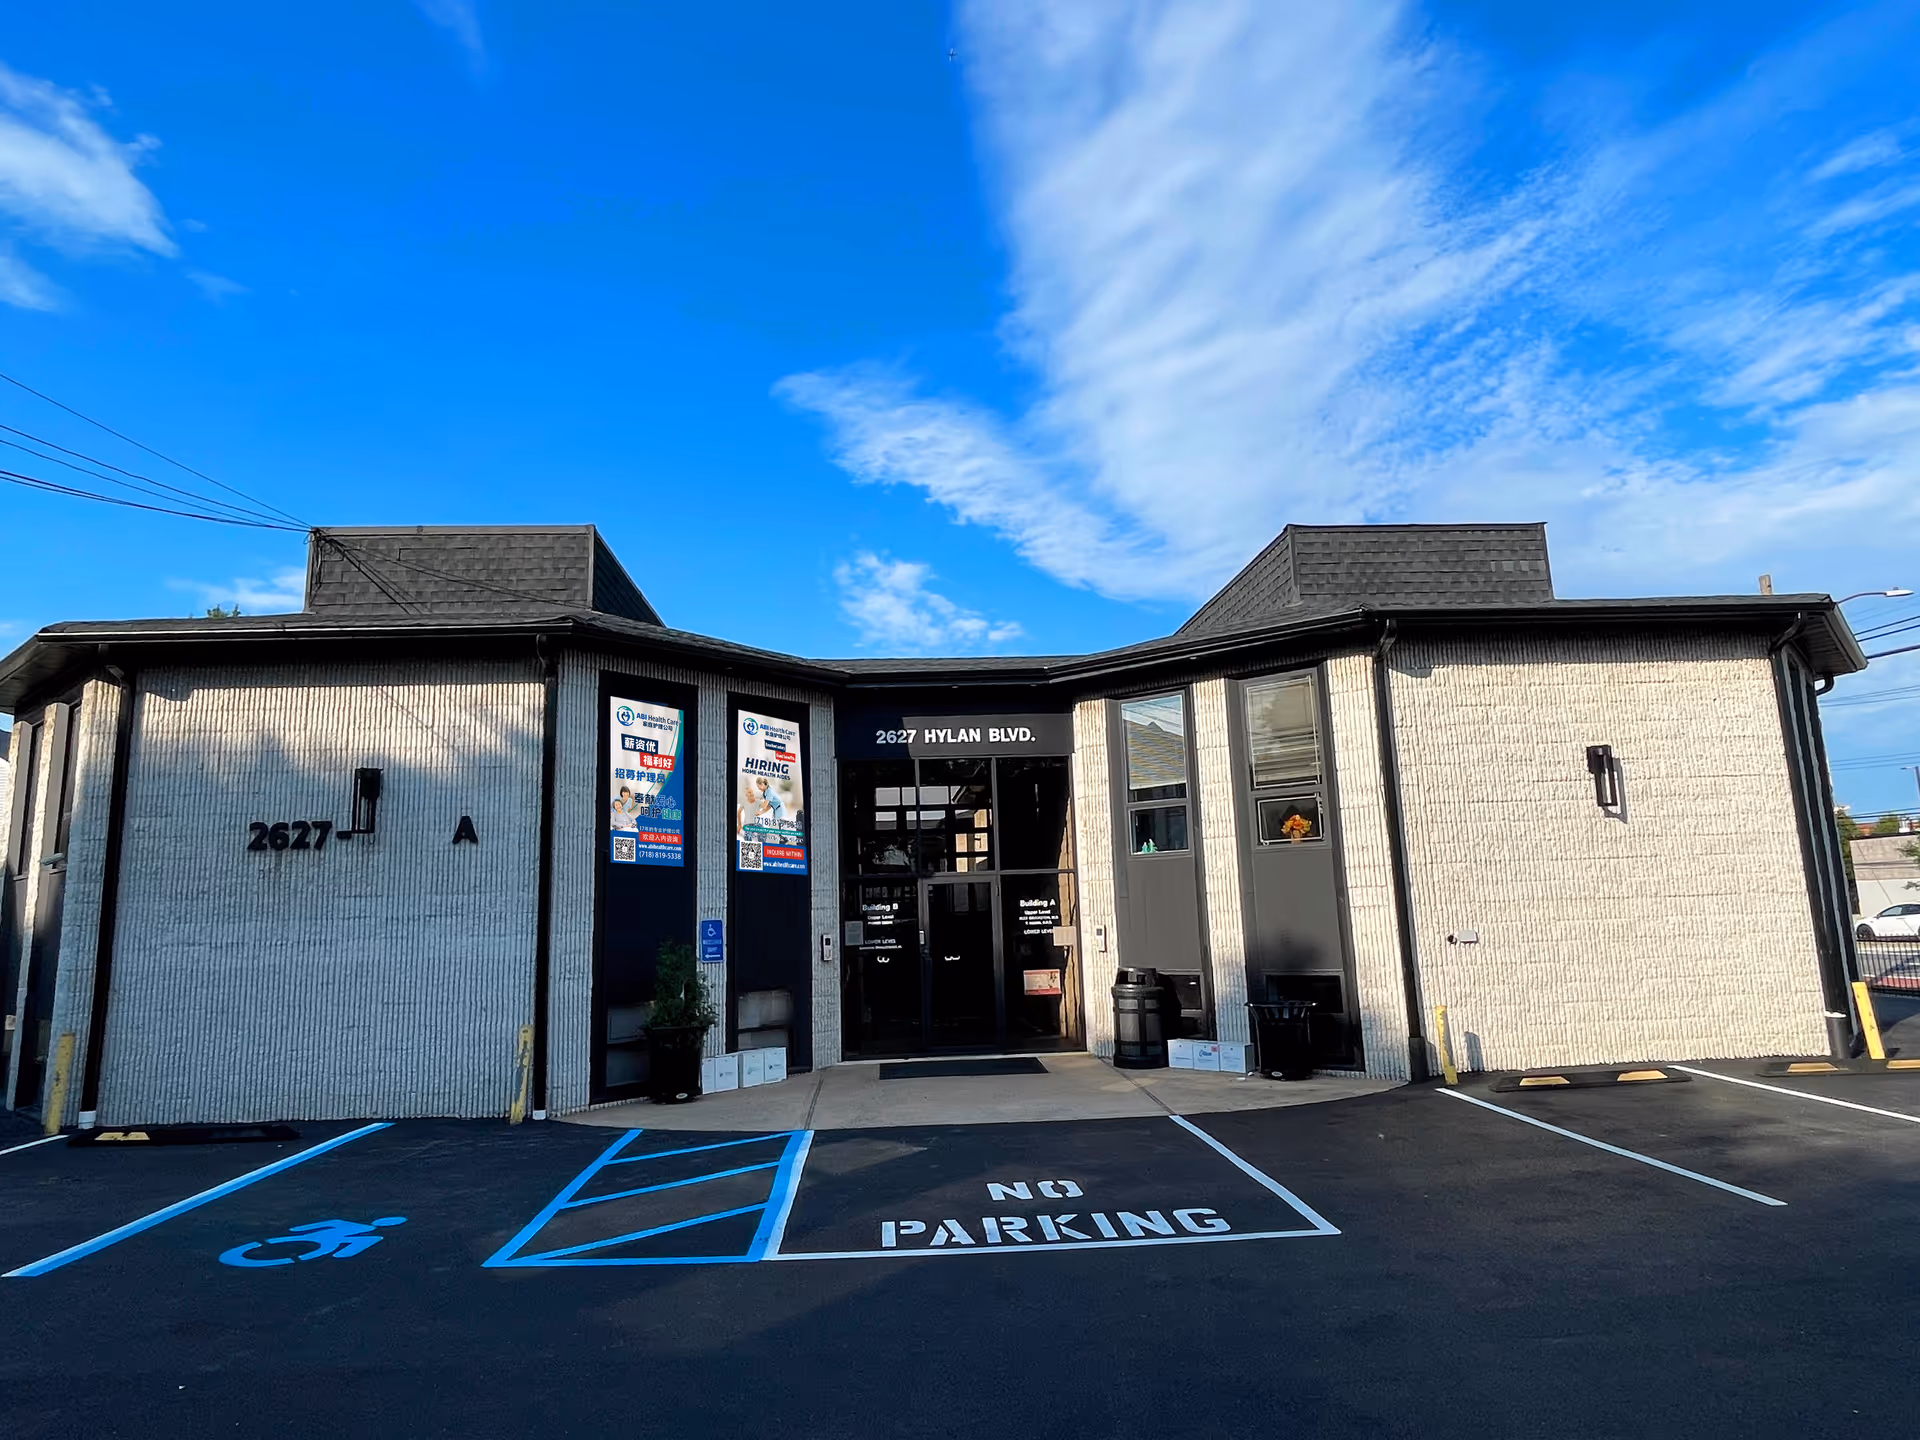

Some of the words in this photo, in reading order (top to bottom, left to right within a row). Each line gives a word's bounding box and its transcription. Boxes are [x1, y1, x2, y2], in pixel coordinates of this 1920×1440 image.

[648, 714, 666, 724] Health
[667, 718, 679, 726] Care
[770, 726, 785, 734] Health
[876, 729, 917, 744] 2627
[924, 728, 980, 744] HYLAN
[988, 727, 1036, 742] BLVD.
[624, 737, 656, 752] 薪资优
[643, 755, 673, 769] 福利好
[745, 757, 789, 775] HIRING
[615, 768, 666, 784] 招募护理员
[641, 806, 682, 820] 呵护健康
[754, 816, 771, 826] (718)
[452, 816, 478, 845] A
[642, 834, 679, 843] 欢迎入内咨询
[862, 903, 891, 912] Building
[1020, 899, 1048, 907] Building
[986, 1179, 1084, 1201] NO
[881, 1208, 1232, 1248] PARKING
